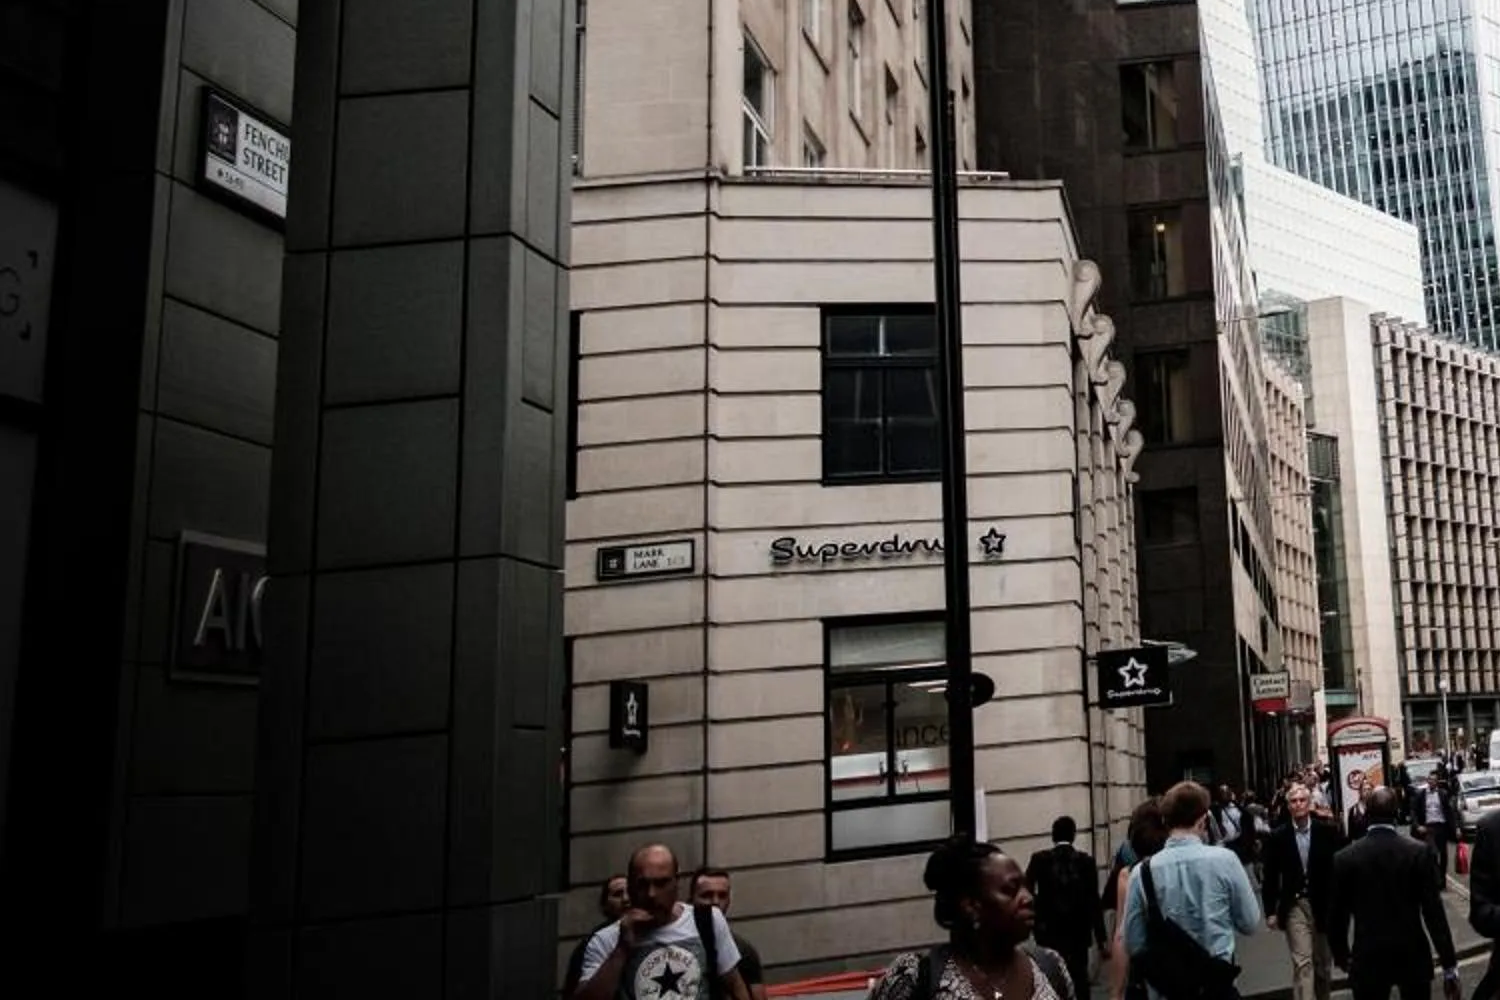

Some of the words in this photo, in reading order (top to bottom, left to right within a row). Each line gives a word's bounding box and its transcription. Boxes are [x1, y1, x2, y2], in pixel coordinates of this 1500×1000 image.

[243, 146, 287, 185] STREET
[633, 547, 665, 558] MARK
[771, 533, 945, 564] Superdru
[633, 558, 660, 569] LANE
